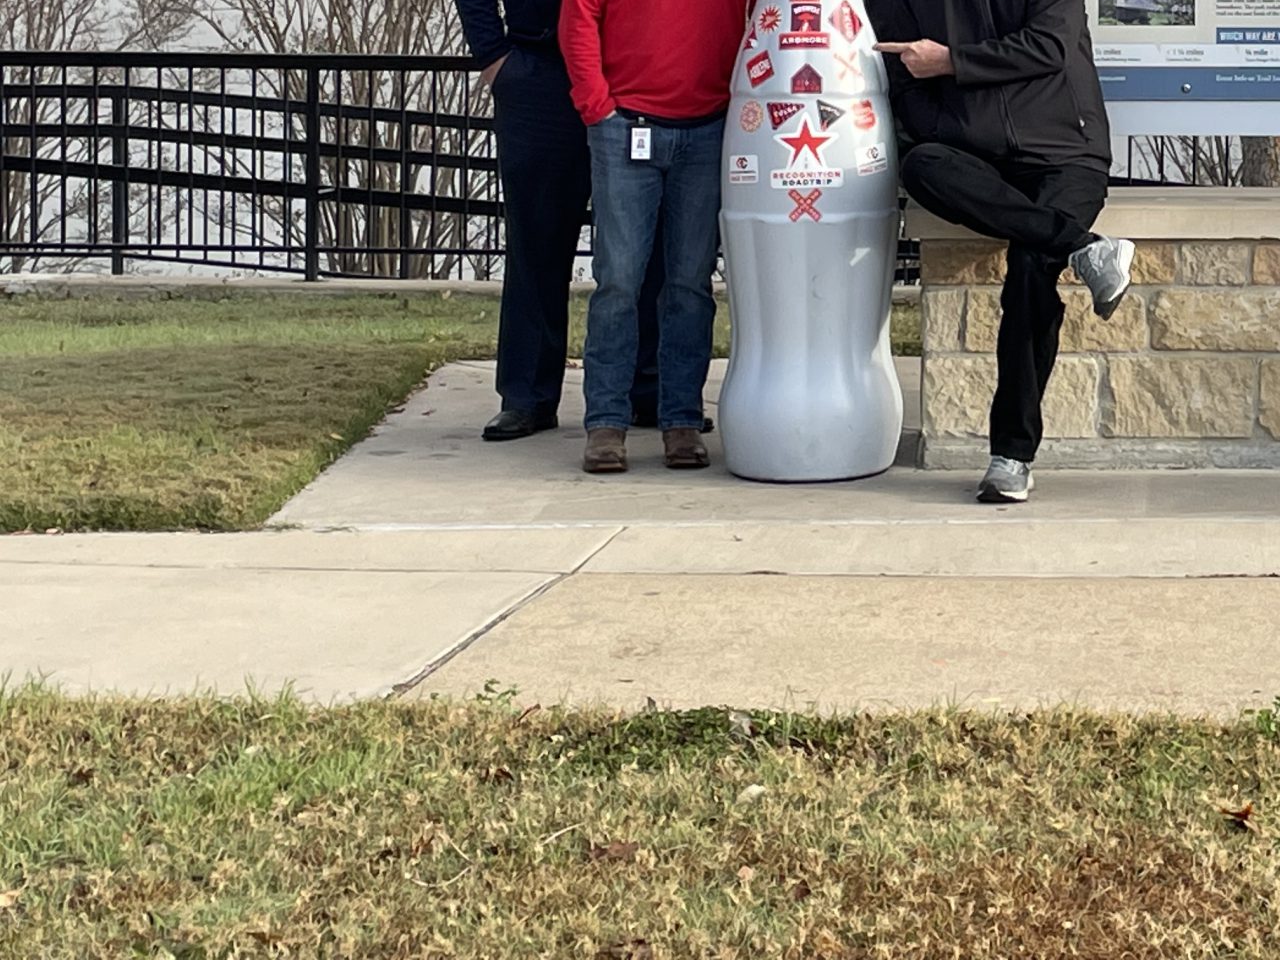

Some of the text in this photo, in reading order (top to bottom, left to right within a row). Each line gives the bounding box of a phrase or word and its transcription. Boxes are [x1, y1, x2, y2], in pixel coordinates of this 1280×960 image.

[781, 36, 828, 44] ARDMORE
[1219, 31, 1243, 41] WHICH
[1245, 31, 1260, 41] WAY
[1262, 31, 1276, 41] ARE
[772, 170, 841, 179] RECOGNITION
[782, 178, 833, 186] ROADTRIP
